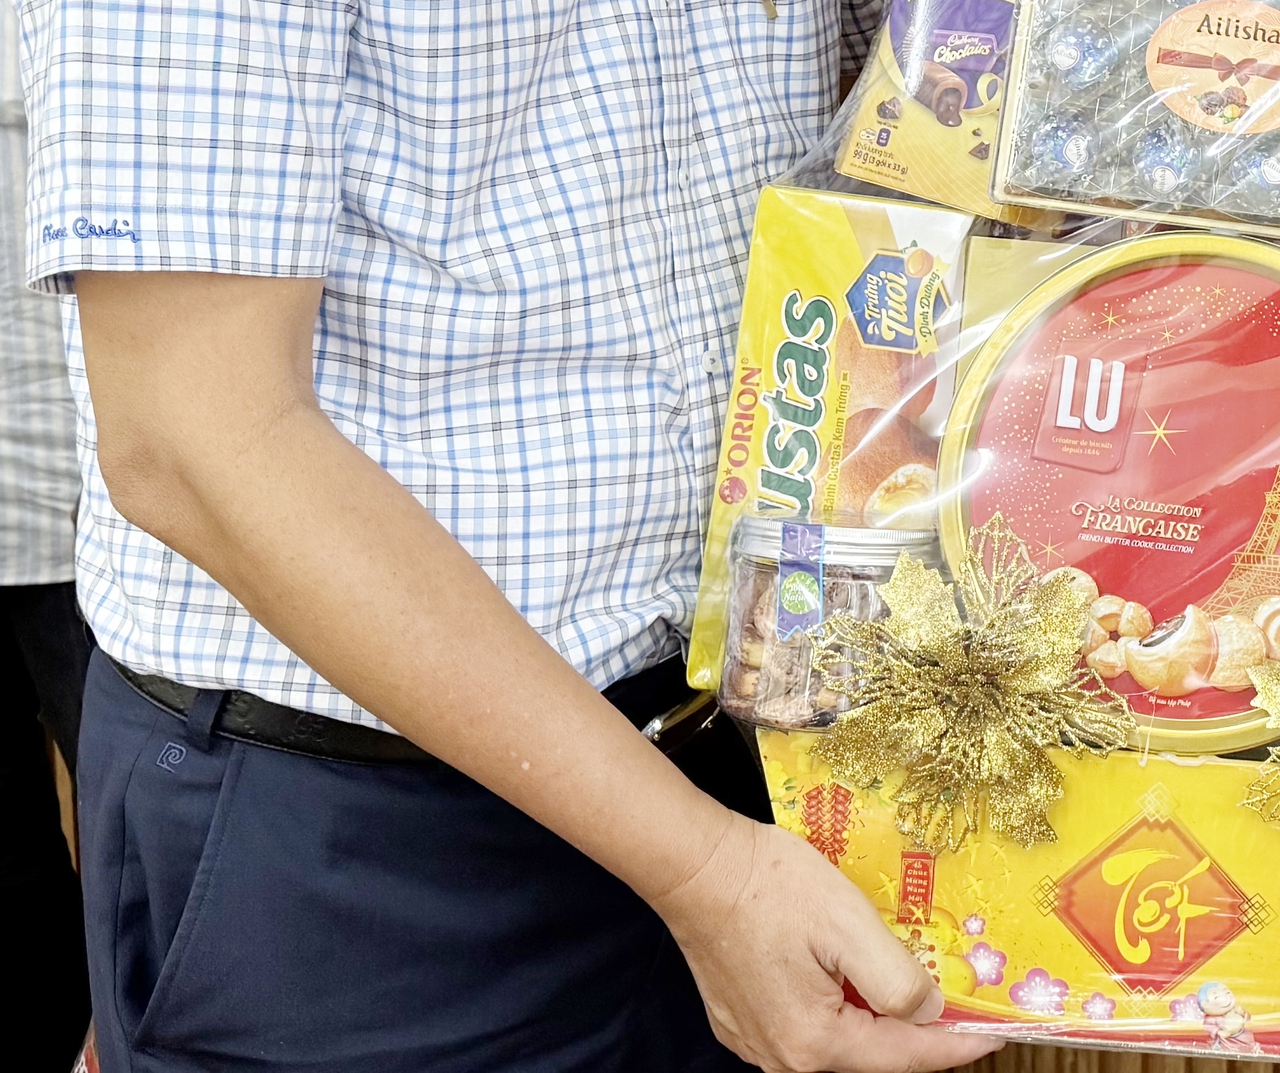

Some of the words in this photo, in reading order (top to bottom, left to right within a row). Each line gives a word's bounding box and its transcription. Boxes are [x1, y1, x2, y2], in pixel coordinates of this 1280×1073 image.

[1196, 13, 1280, 44] Ailisha
[933, 43, 992, 64] Choclairs
[852, 150, 863, 160] 99
[72, 216, 140, 244] Cardin
[879, 270, 915, 342] Tươi
[919, 310, 932, 338] Dinh
[757, 291, 837, 520] ustas
[1055, 354, 1126, 433] LU
[727, 367, 763, 469] ORION
[832, 414, 846, 442] Kem
[1062, 446, 1083, 455] depuis
[1080, 438, 1088, 446] de
[828, 443, 842, 479] Custas
[822, 480, 836, 512] Bánh
[1078, 532, 1103, 543] FRENCH
[1104, 536, 1131, 547] BUTTER
[1131, 539, 1155, 549] COOKIE
[1155, 542, 1195, 555] COLLECTION
